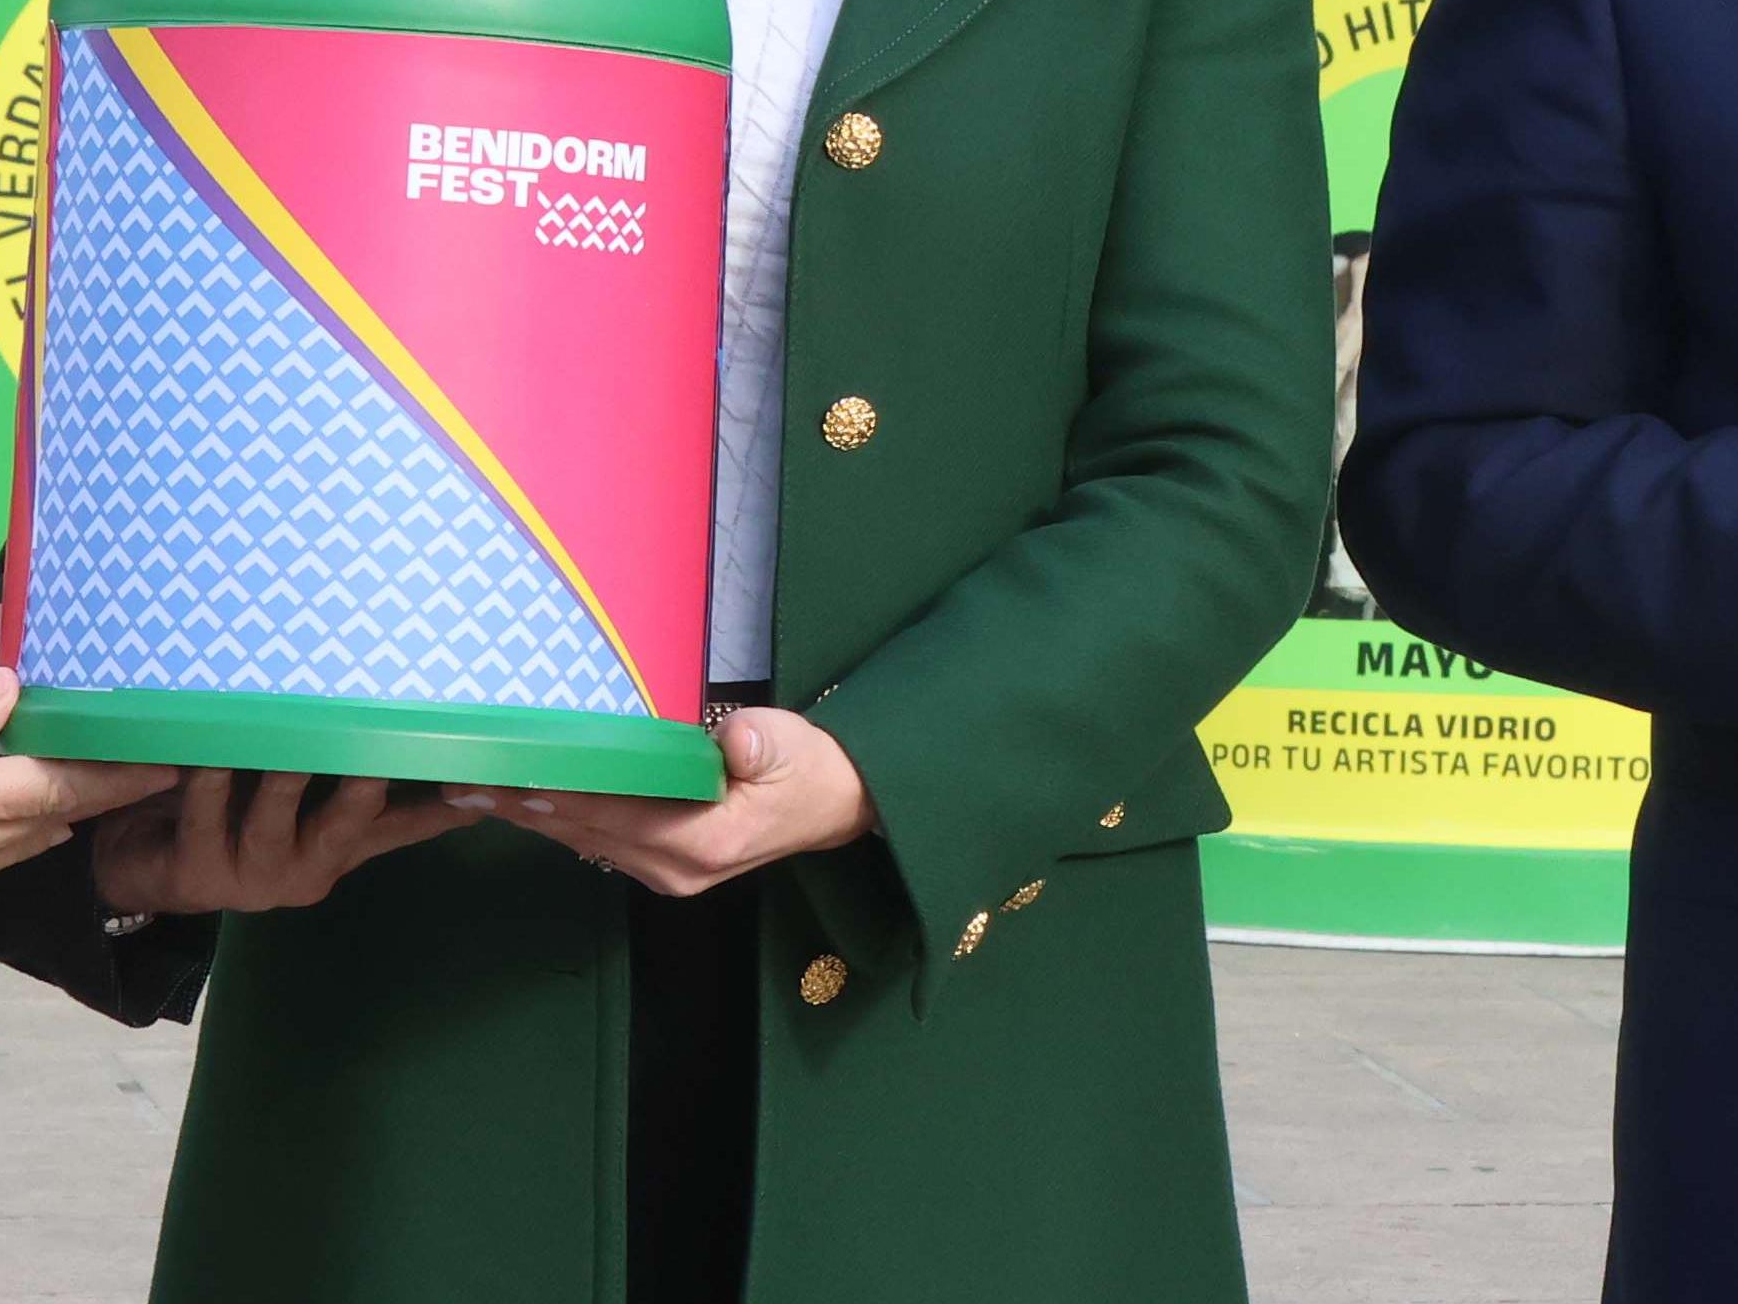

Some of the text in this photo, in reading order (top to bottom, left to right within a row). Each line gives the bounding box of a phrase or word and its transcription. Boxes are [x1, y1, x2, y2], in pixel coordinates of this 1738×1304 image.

[408, 122, 647, 182] BENIDORM
[406, 161, 539, 208] FEST
[1287, 709, 1558, 743] RECICLA VIDRIO
[1211, 742, 1651, 783] POR TU ARTISTA FAVORITO
